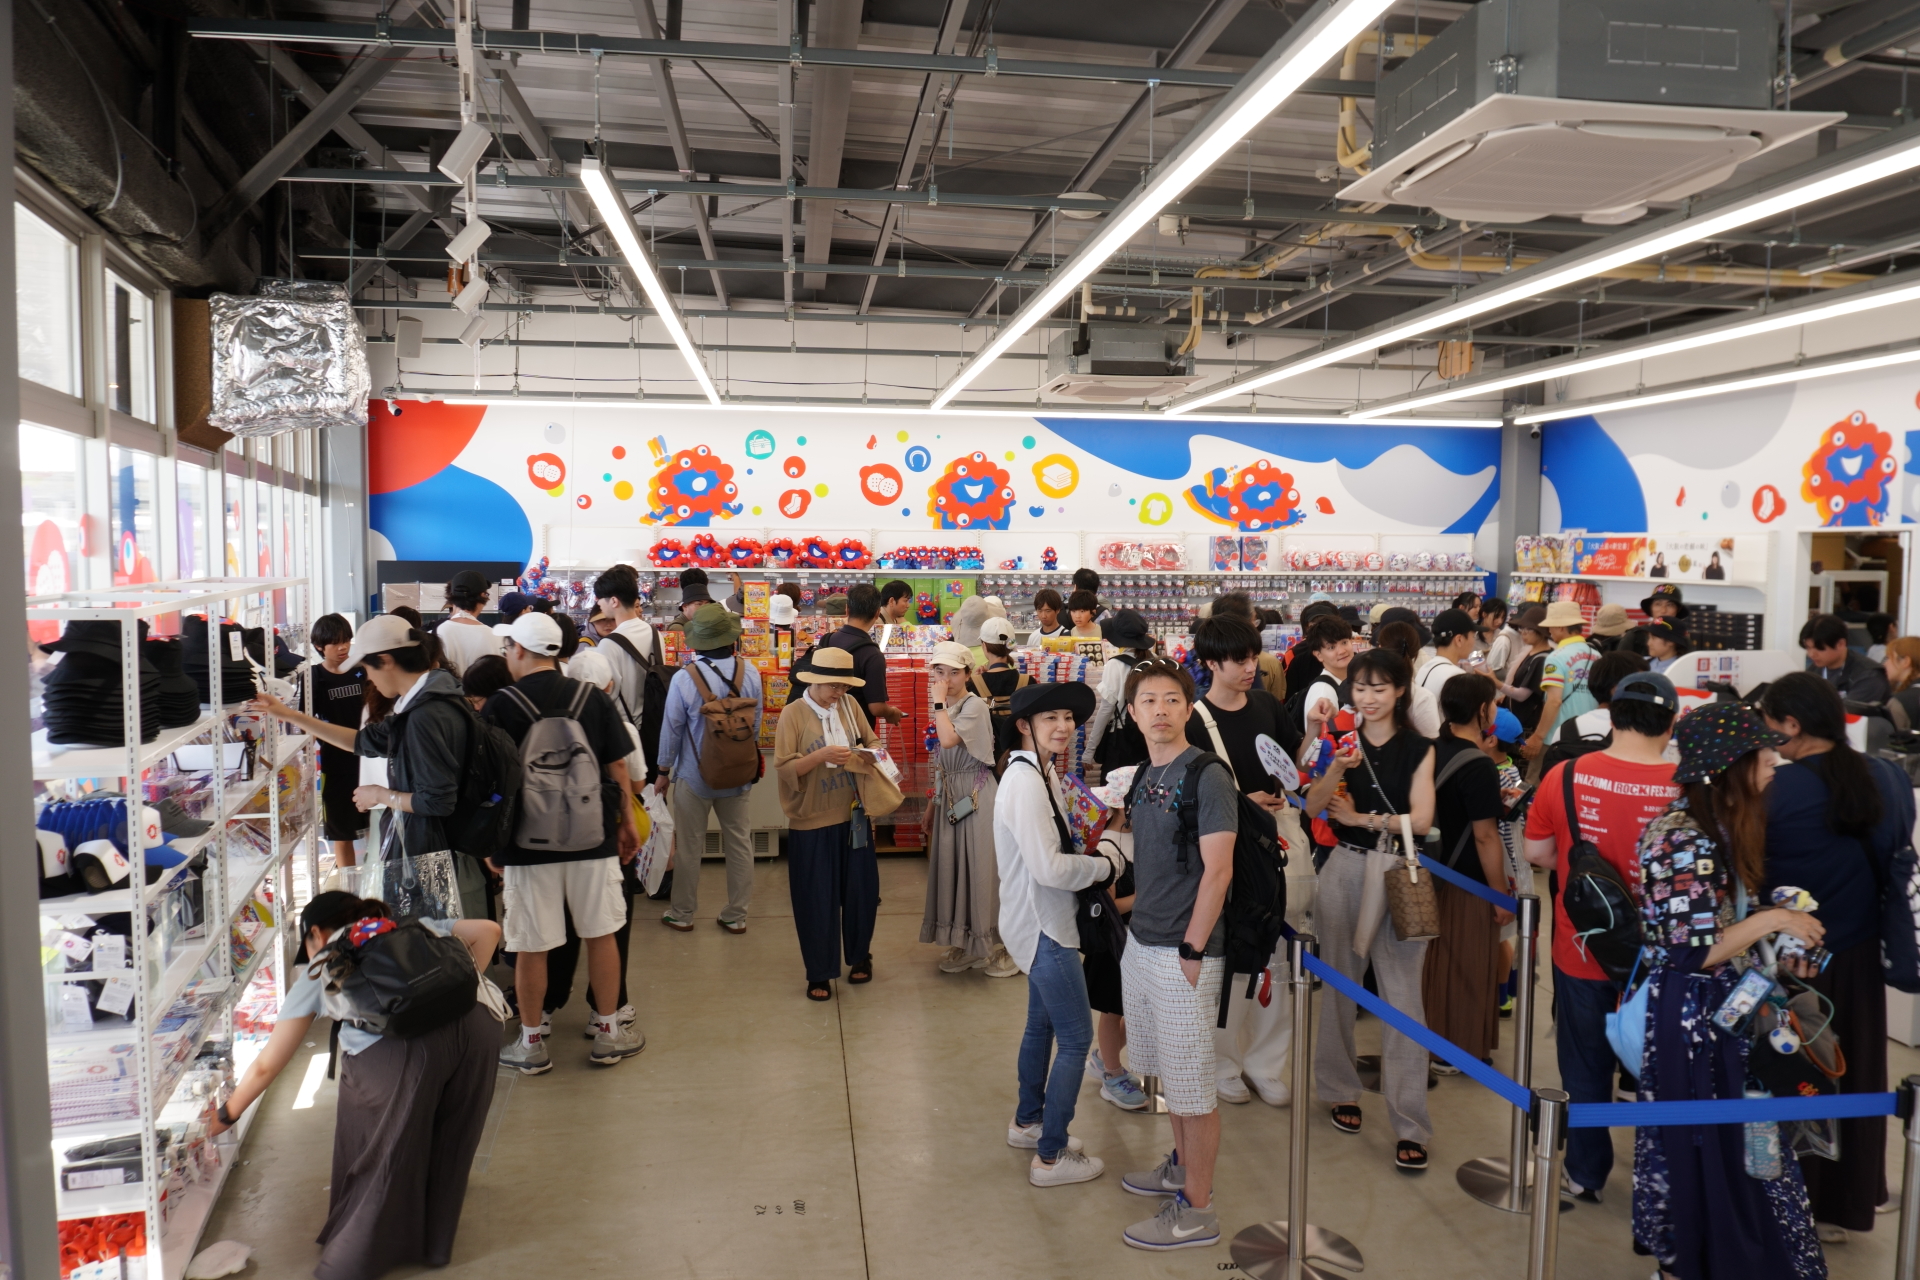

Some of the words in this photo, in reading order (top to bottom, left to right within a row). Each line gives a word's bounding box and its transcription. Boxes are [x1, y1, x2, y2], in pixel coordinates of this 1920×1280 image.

[327, 684, 362, 700] PUMA
[1573, 772, 1613, 792] INAZUMA
[1614, 781, 1650, 796] ROCK
